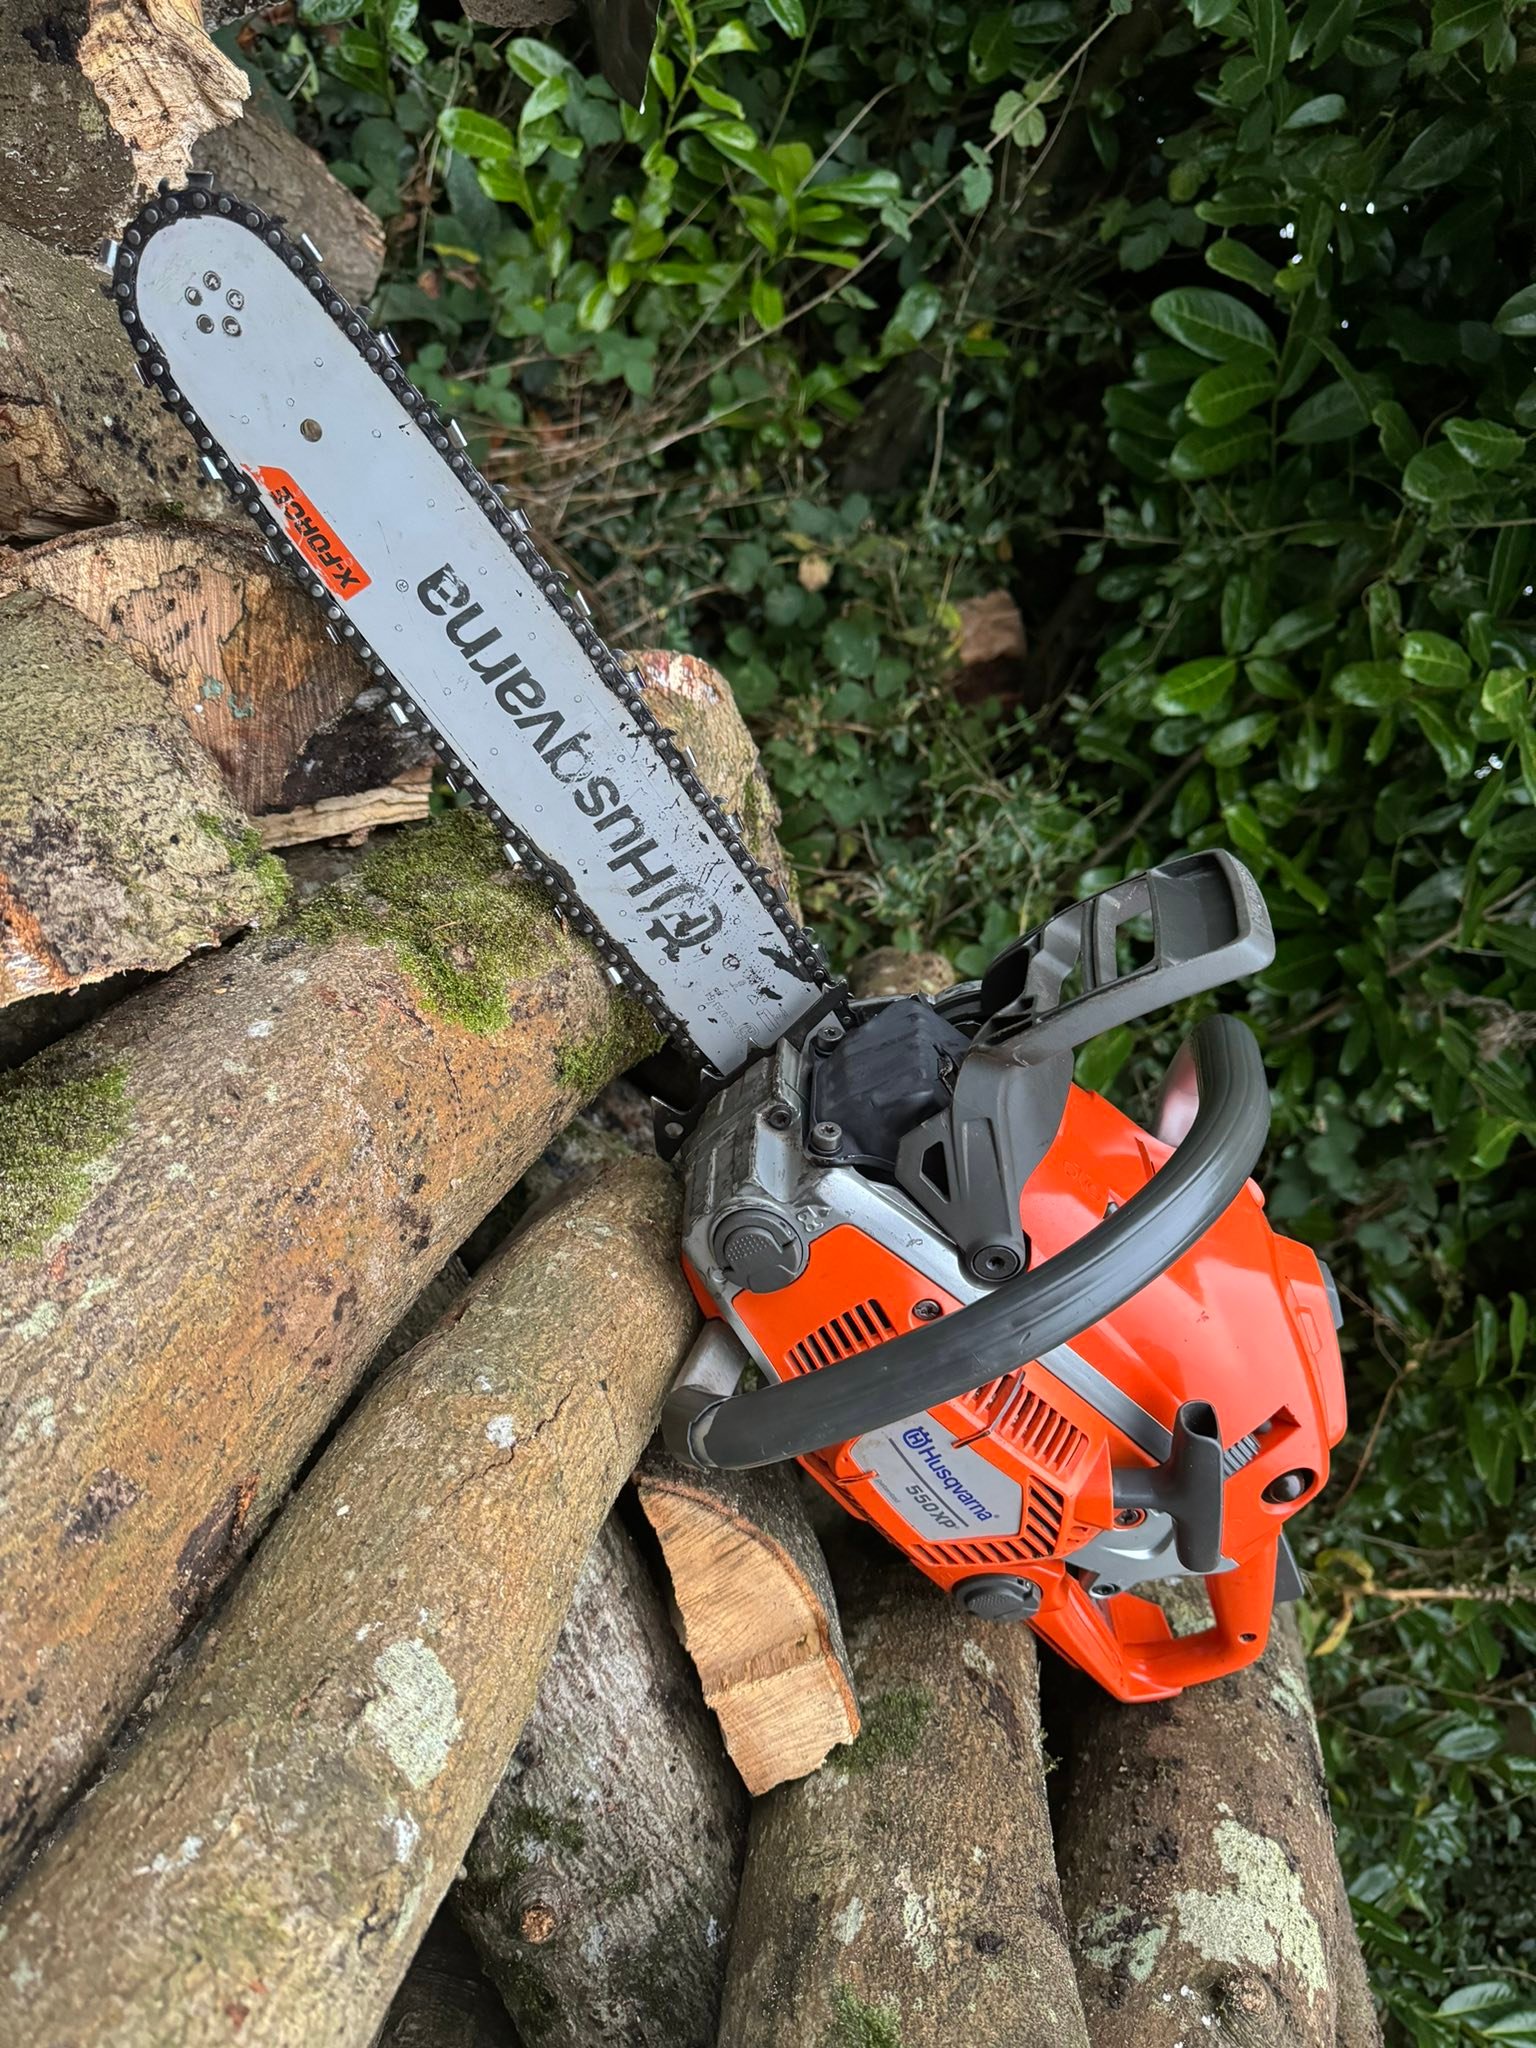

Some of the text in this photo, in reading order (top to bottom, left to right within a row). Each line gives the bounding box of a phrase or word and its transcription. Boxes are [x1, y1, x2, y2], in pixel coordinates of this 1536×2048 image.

[270, 485, 361, 589] X-FORCE
[416, 562, 677, 898] Husqvarna
[917, 1444, 993, 1522] Husqvarna
